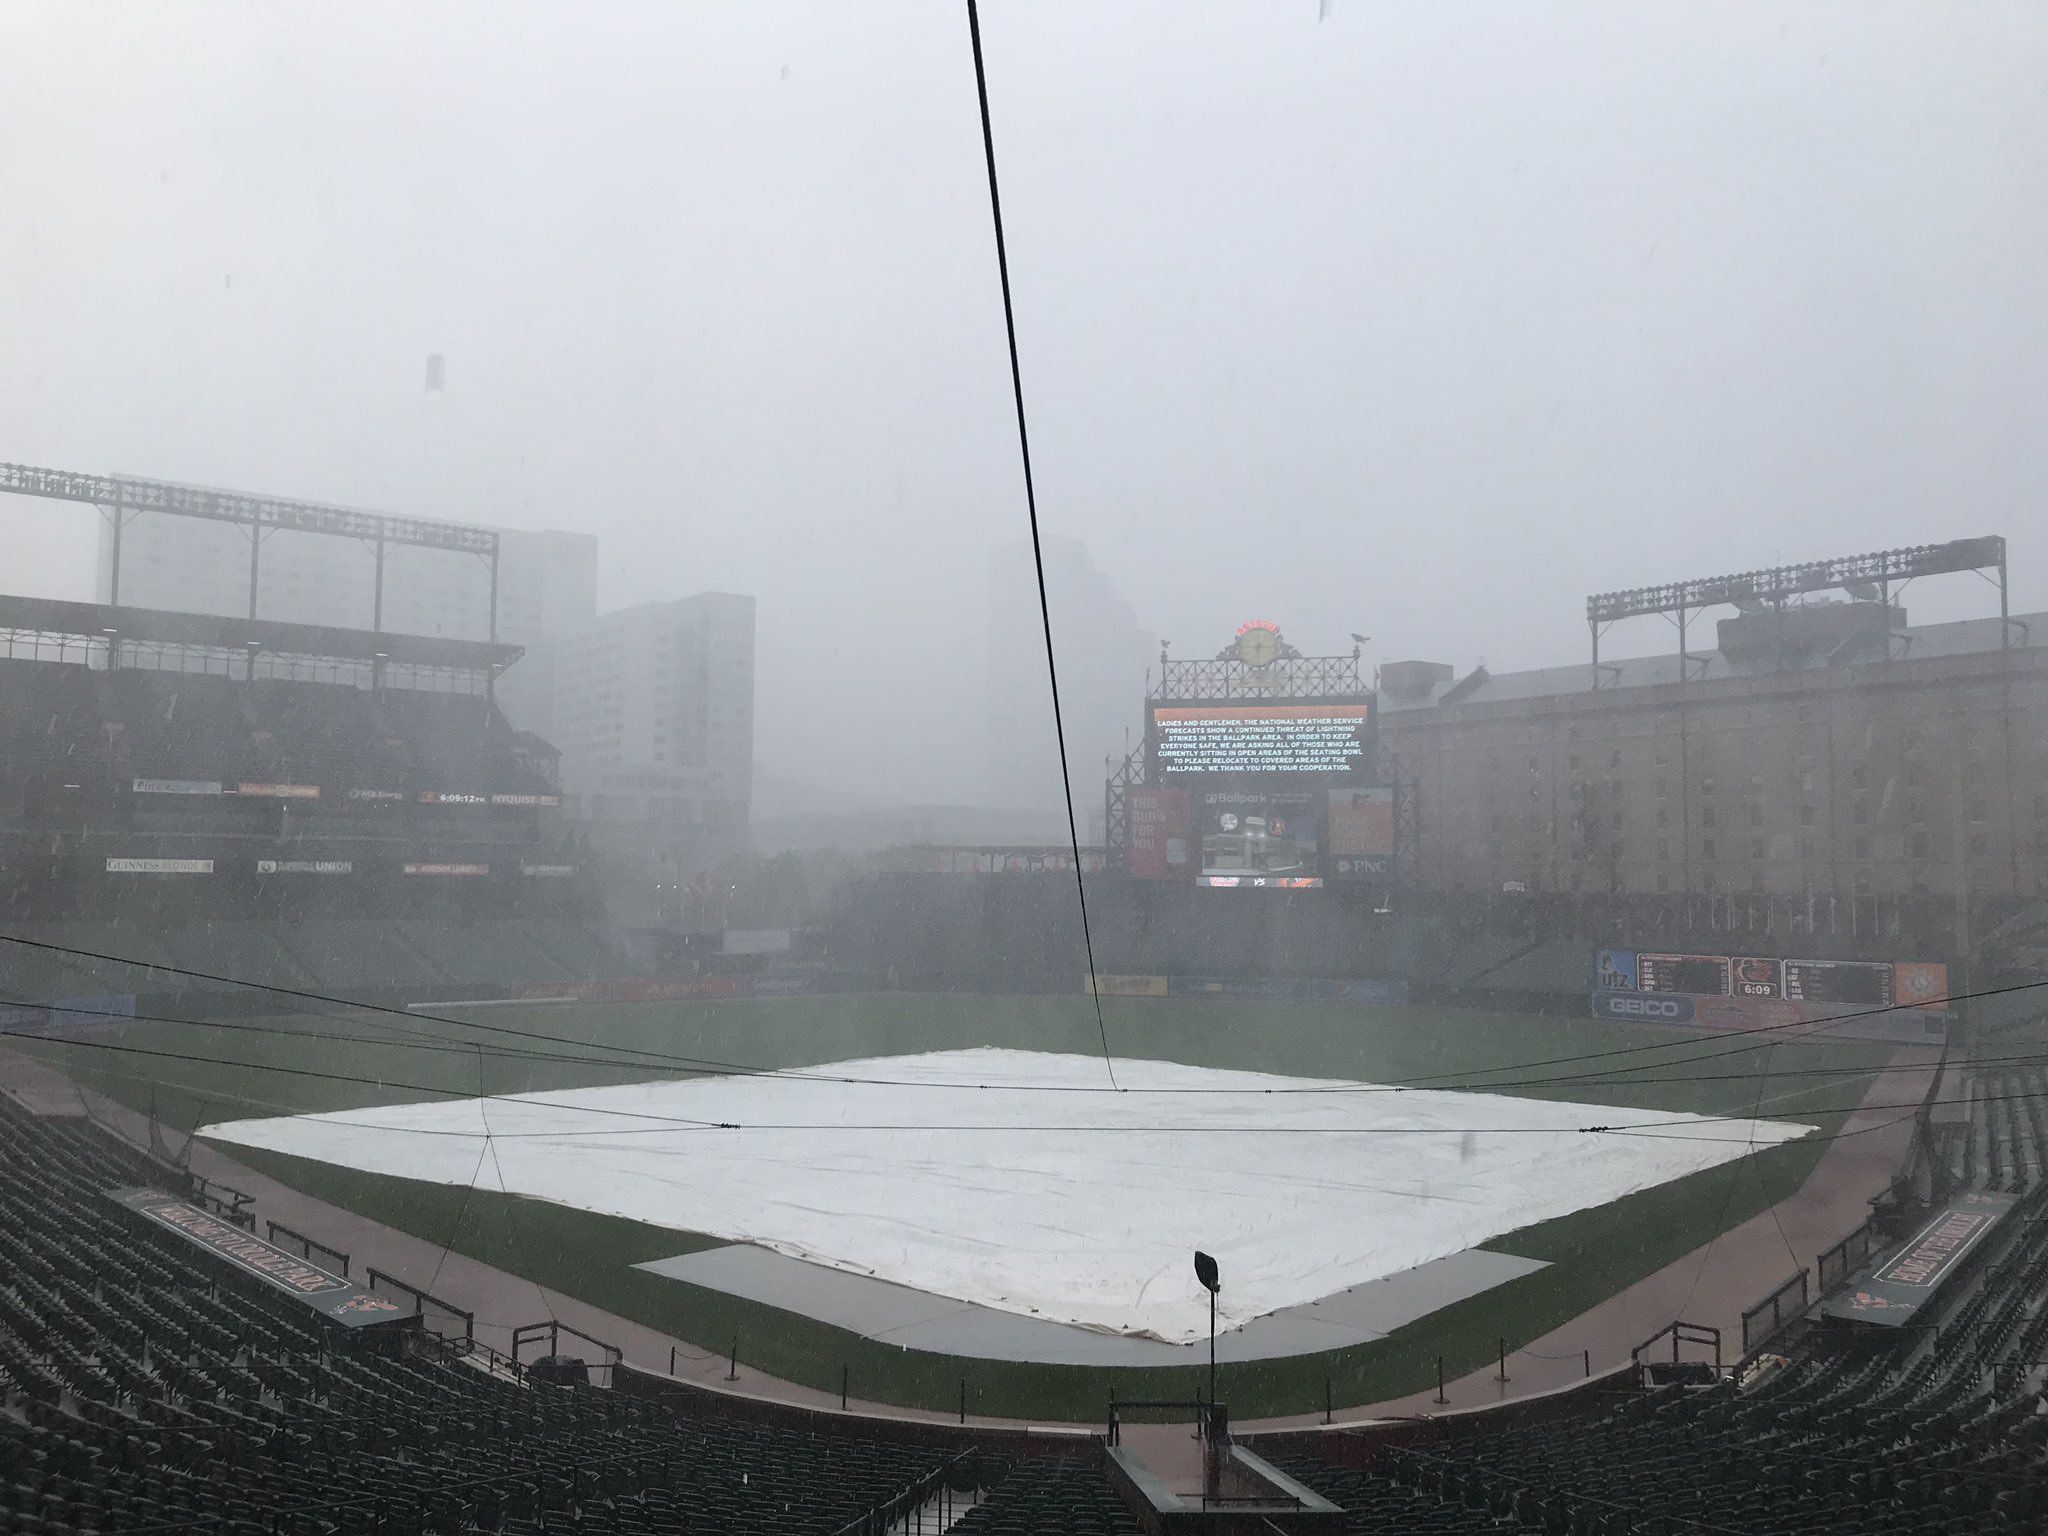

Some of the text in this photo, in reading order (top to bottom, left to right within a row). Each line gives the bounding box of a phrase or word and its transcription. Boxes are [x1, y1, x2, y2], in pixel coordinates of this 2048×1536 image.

[492, 794, 536, 805] NYQUIST
[1132, 797, 1158, 809] THIS
[1218, 793, 1266, 804] Ballpark
[1133, 824, 1154, 836] FOR
[108, 861, 199, 871] GUINNESS BLONDE
[316, 861, 352, 872] UNION
[1353, 860, 1387, 872] PNC
[1744, 984, 1771, 995] 6:09
[1610, 998, 1679, 1017] GEICO
